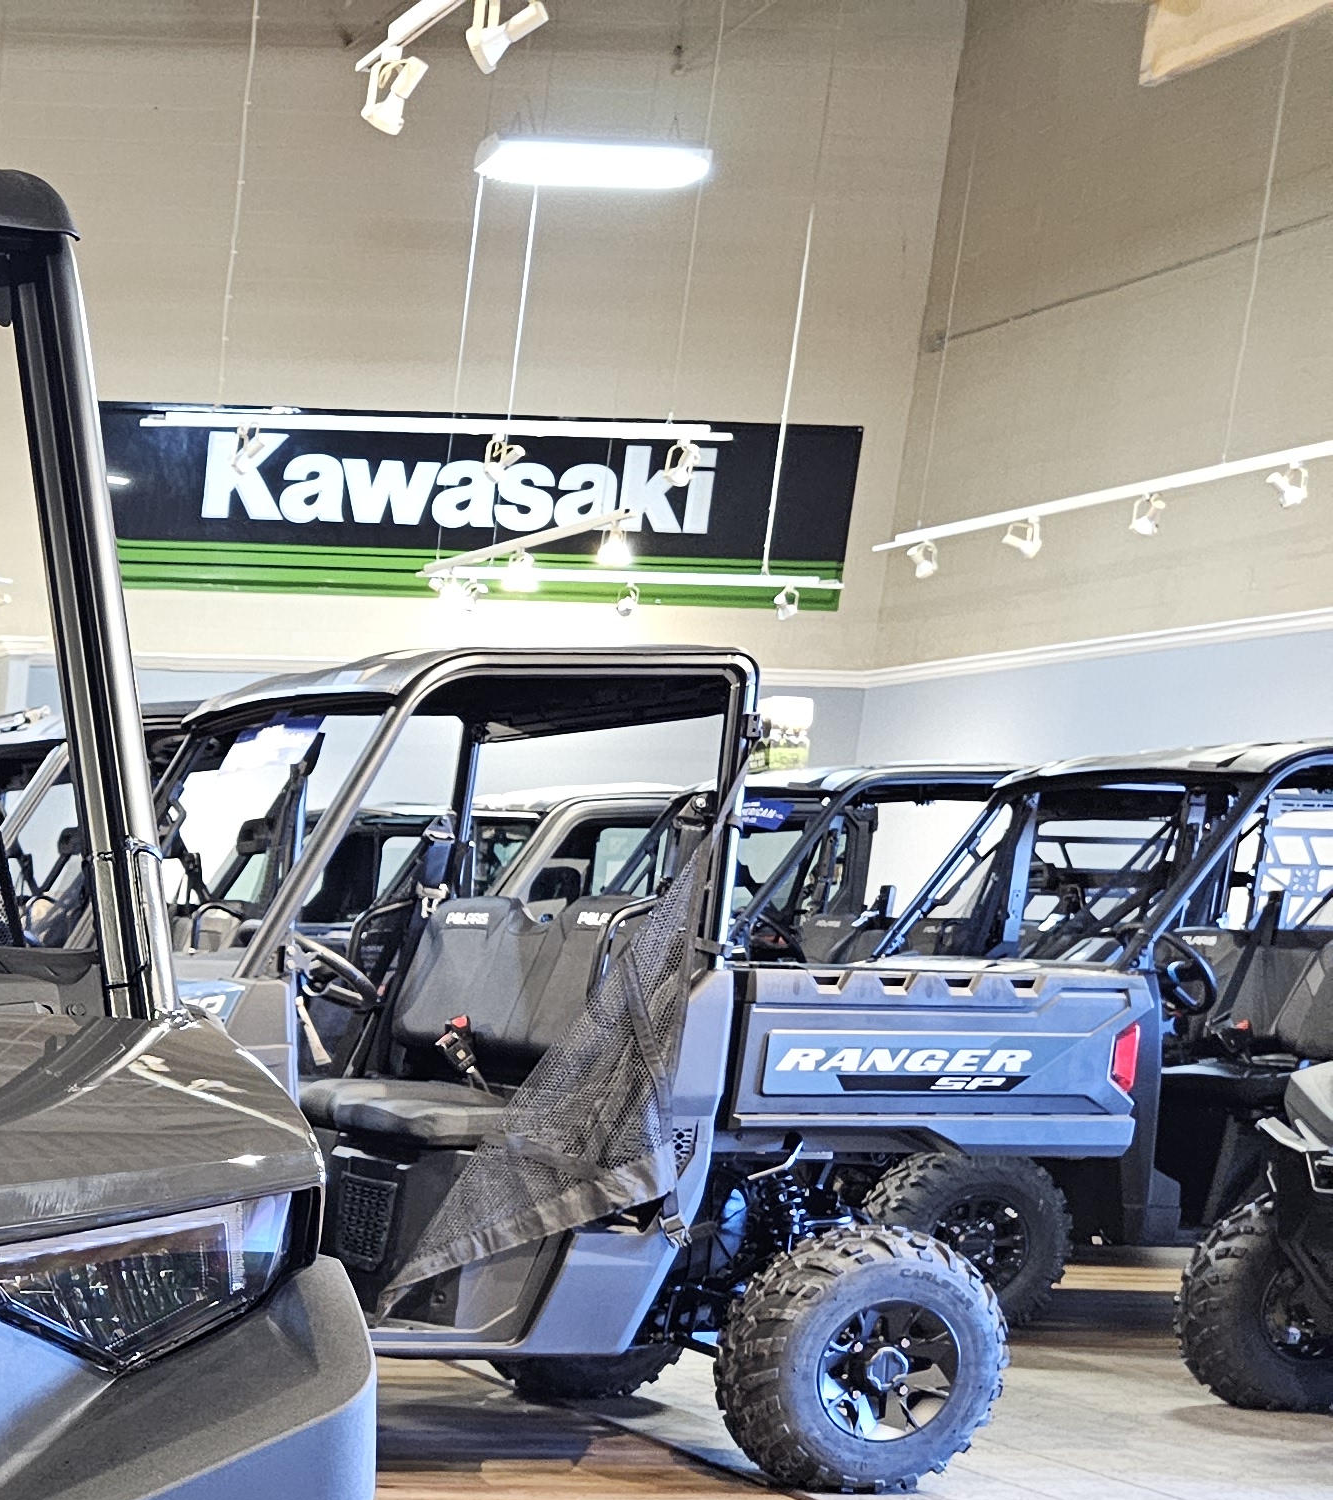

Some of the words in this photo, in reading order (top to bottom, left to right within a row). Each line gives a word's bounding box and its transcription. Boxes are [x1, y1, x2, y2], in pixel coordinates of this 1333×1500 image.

[200, 430, 718, 535] Kawasaki
[775, 1048, 1032, 1073] RANGER
[930, 1076, 1007, 1091] SP
